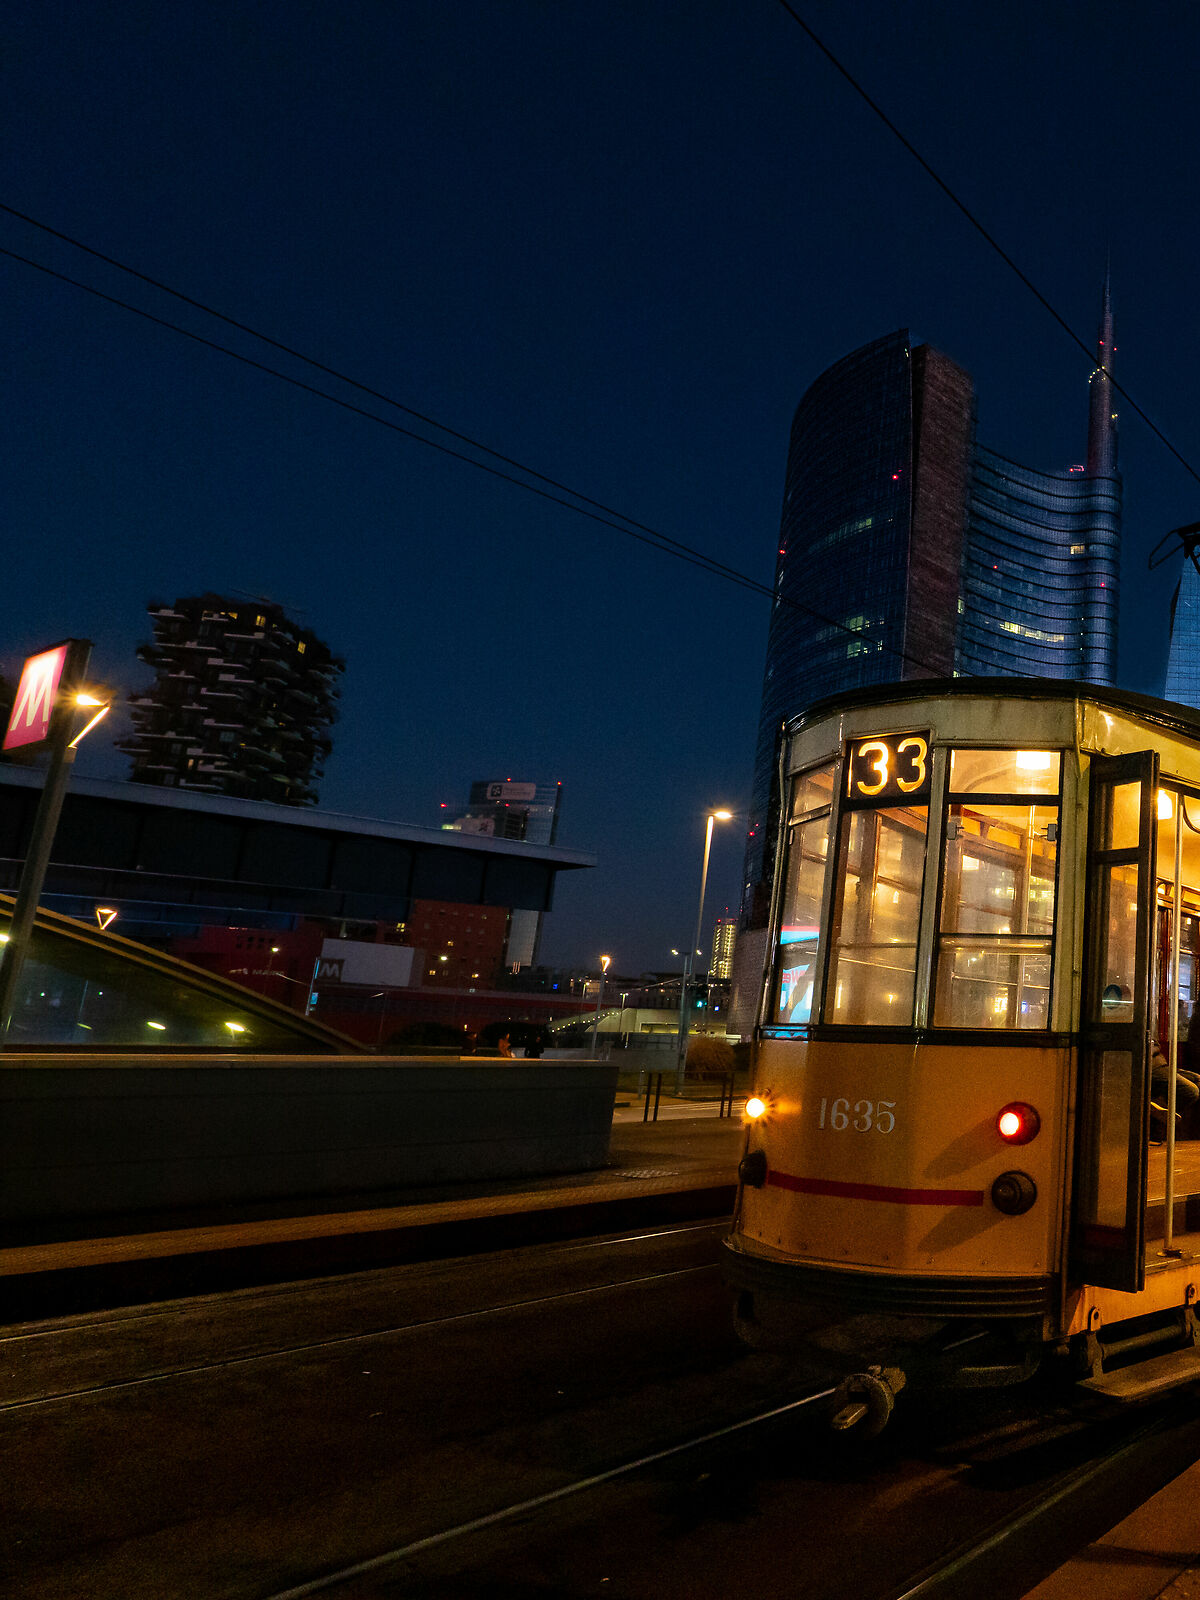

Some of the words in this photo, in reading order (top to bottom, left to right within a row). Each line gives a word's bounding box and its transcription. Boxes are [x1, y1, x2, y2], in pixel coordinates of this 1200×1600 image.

[10, 669, 54, 732] M
[856, 737, 927, 796] 33
[819, 1097, 897, 1134] 1635
